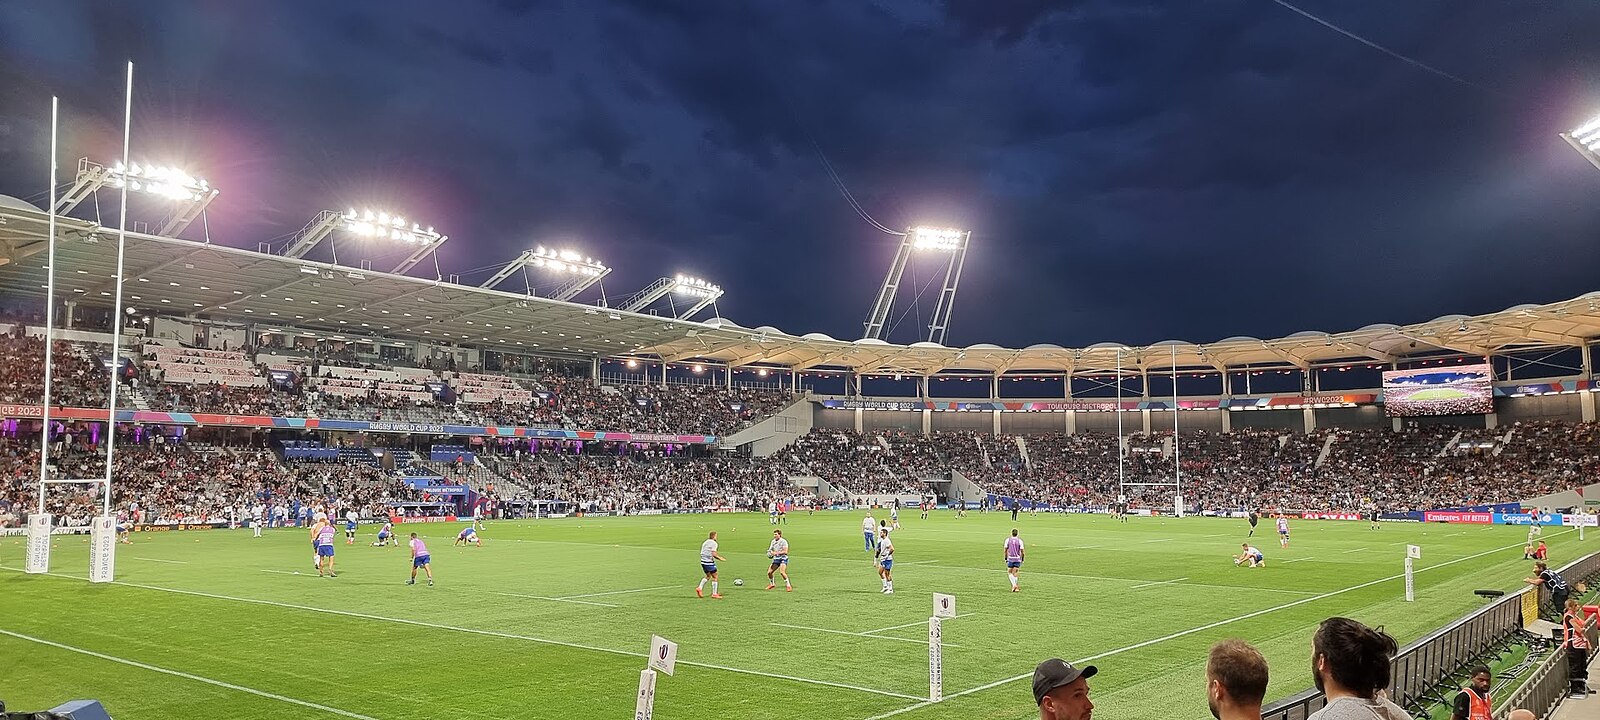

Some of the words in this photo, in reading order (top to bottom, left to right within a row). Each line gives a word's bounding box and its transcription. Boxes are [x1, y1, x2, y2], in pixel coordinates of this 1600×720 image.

[1303, 396, 1344, 404] #RWC2023
[17, 407, 42, 416] 2023
[369, 422, 391, 430] RUGBY
[392, 423, 415, 431] WORLD
[415, 424, 428, 432] CUP
[1427, 513, 1460, 521] Emirates
